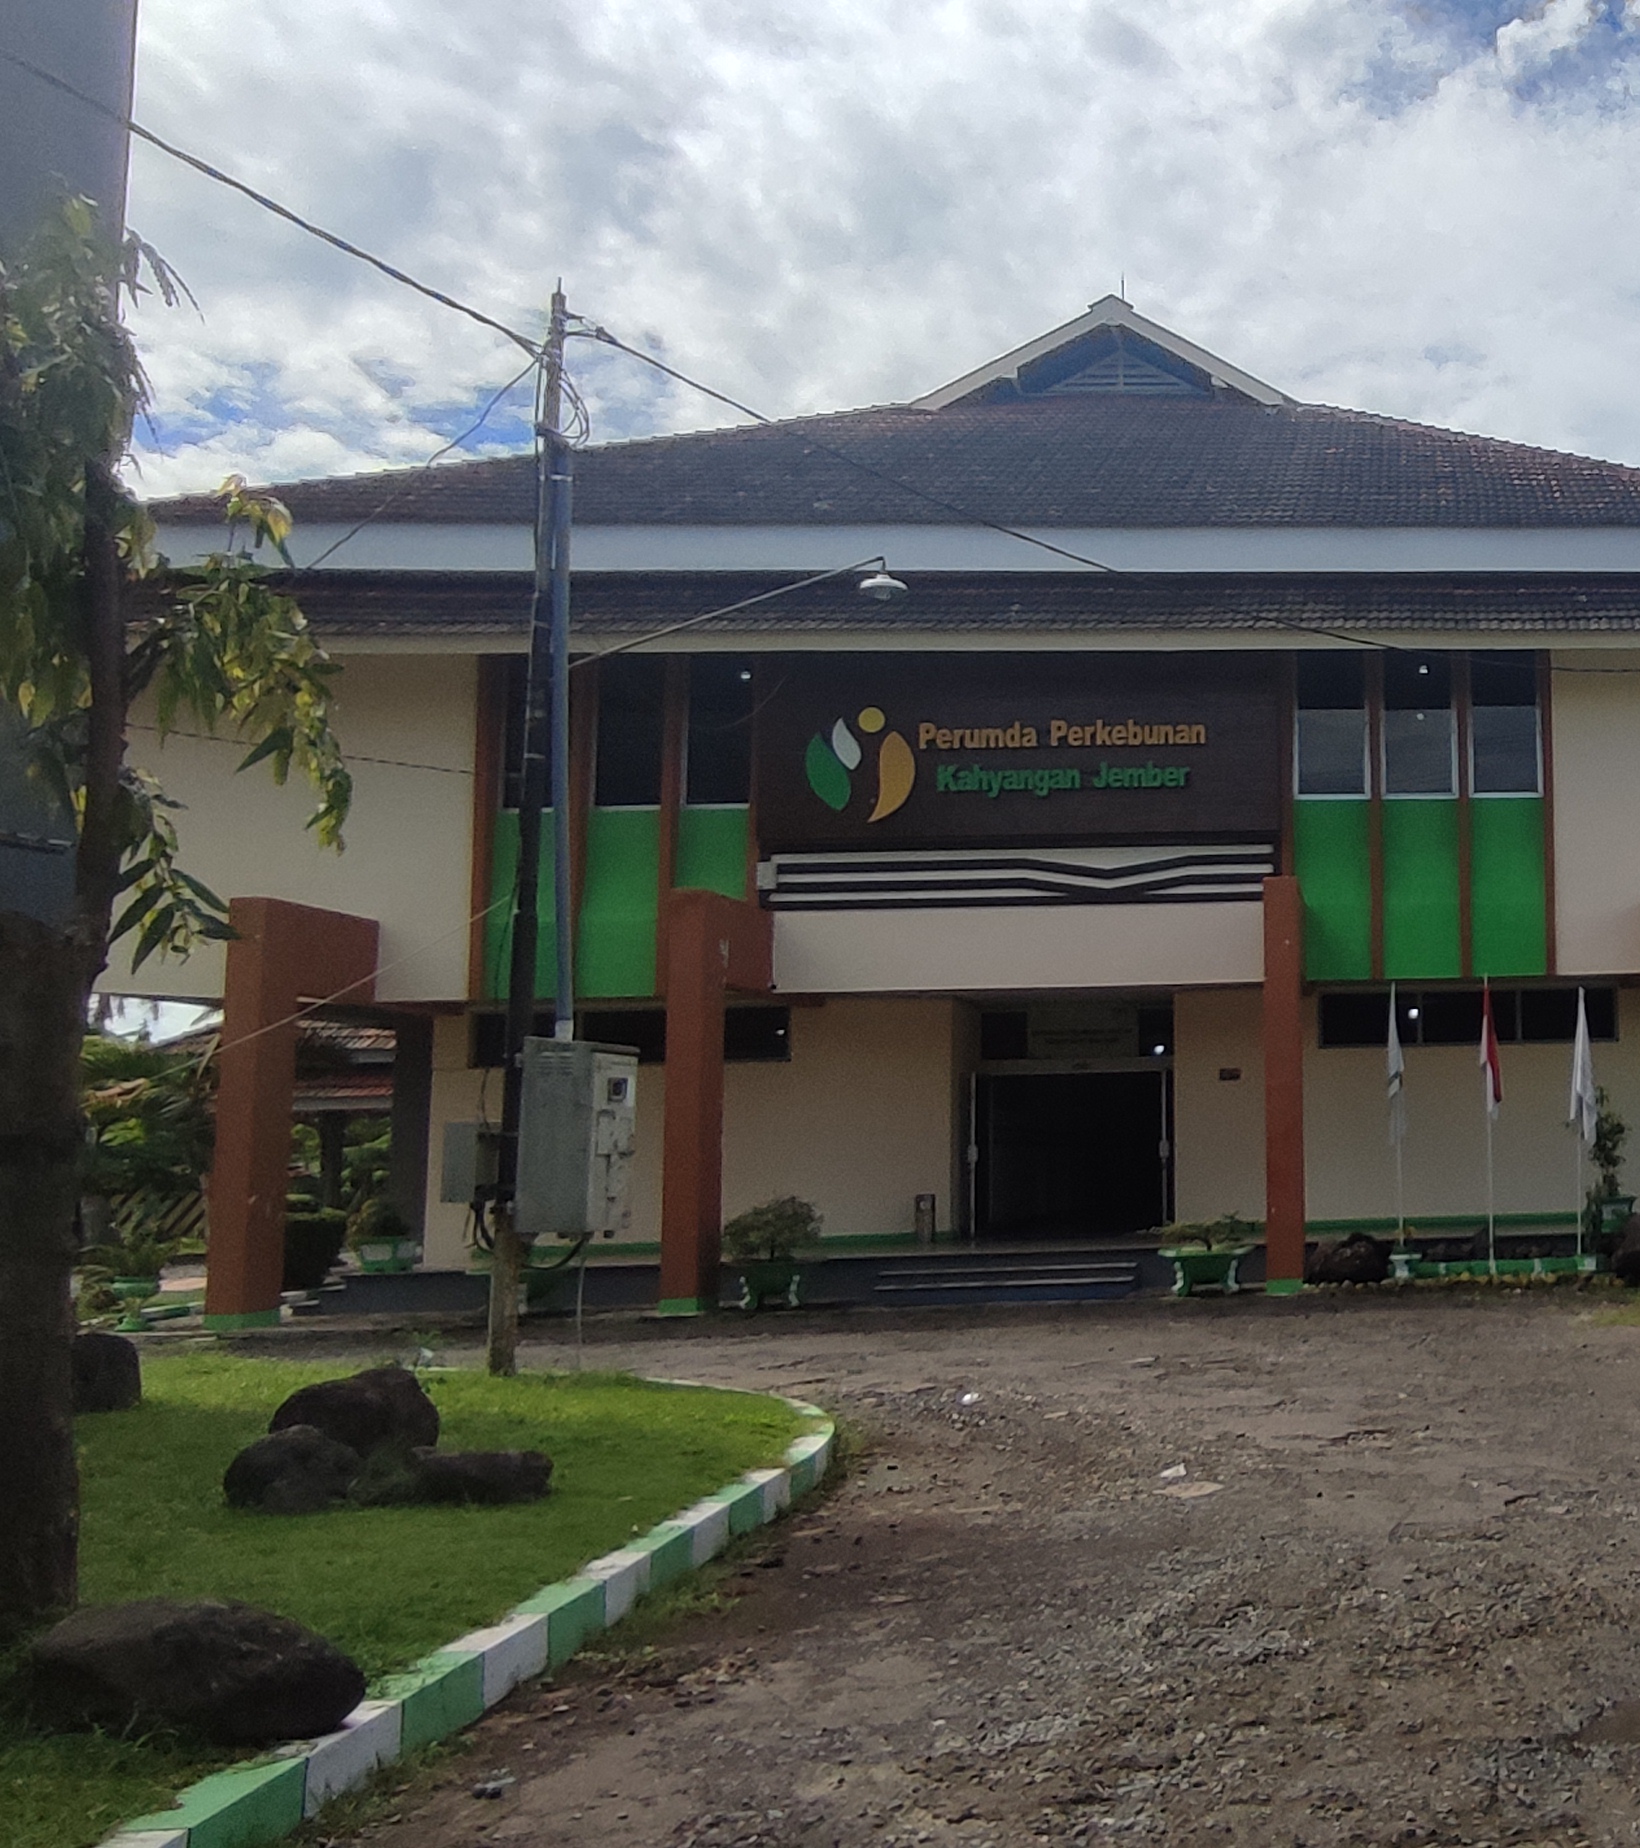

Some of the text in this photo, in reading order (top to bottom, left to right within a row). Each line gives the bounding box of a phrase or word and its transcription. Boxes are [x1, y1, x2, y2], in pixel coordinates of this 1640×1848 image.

[918, 719, 1206, 749] Perumda Perkebunan
[936, 761, 1190, 798] Kahyangan Jember
